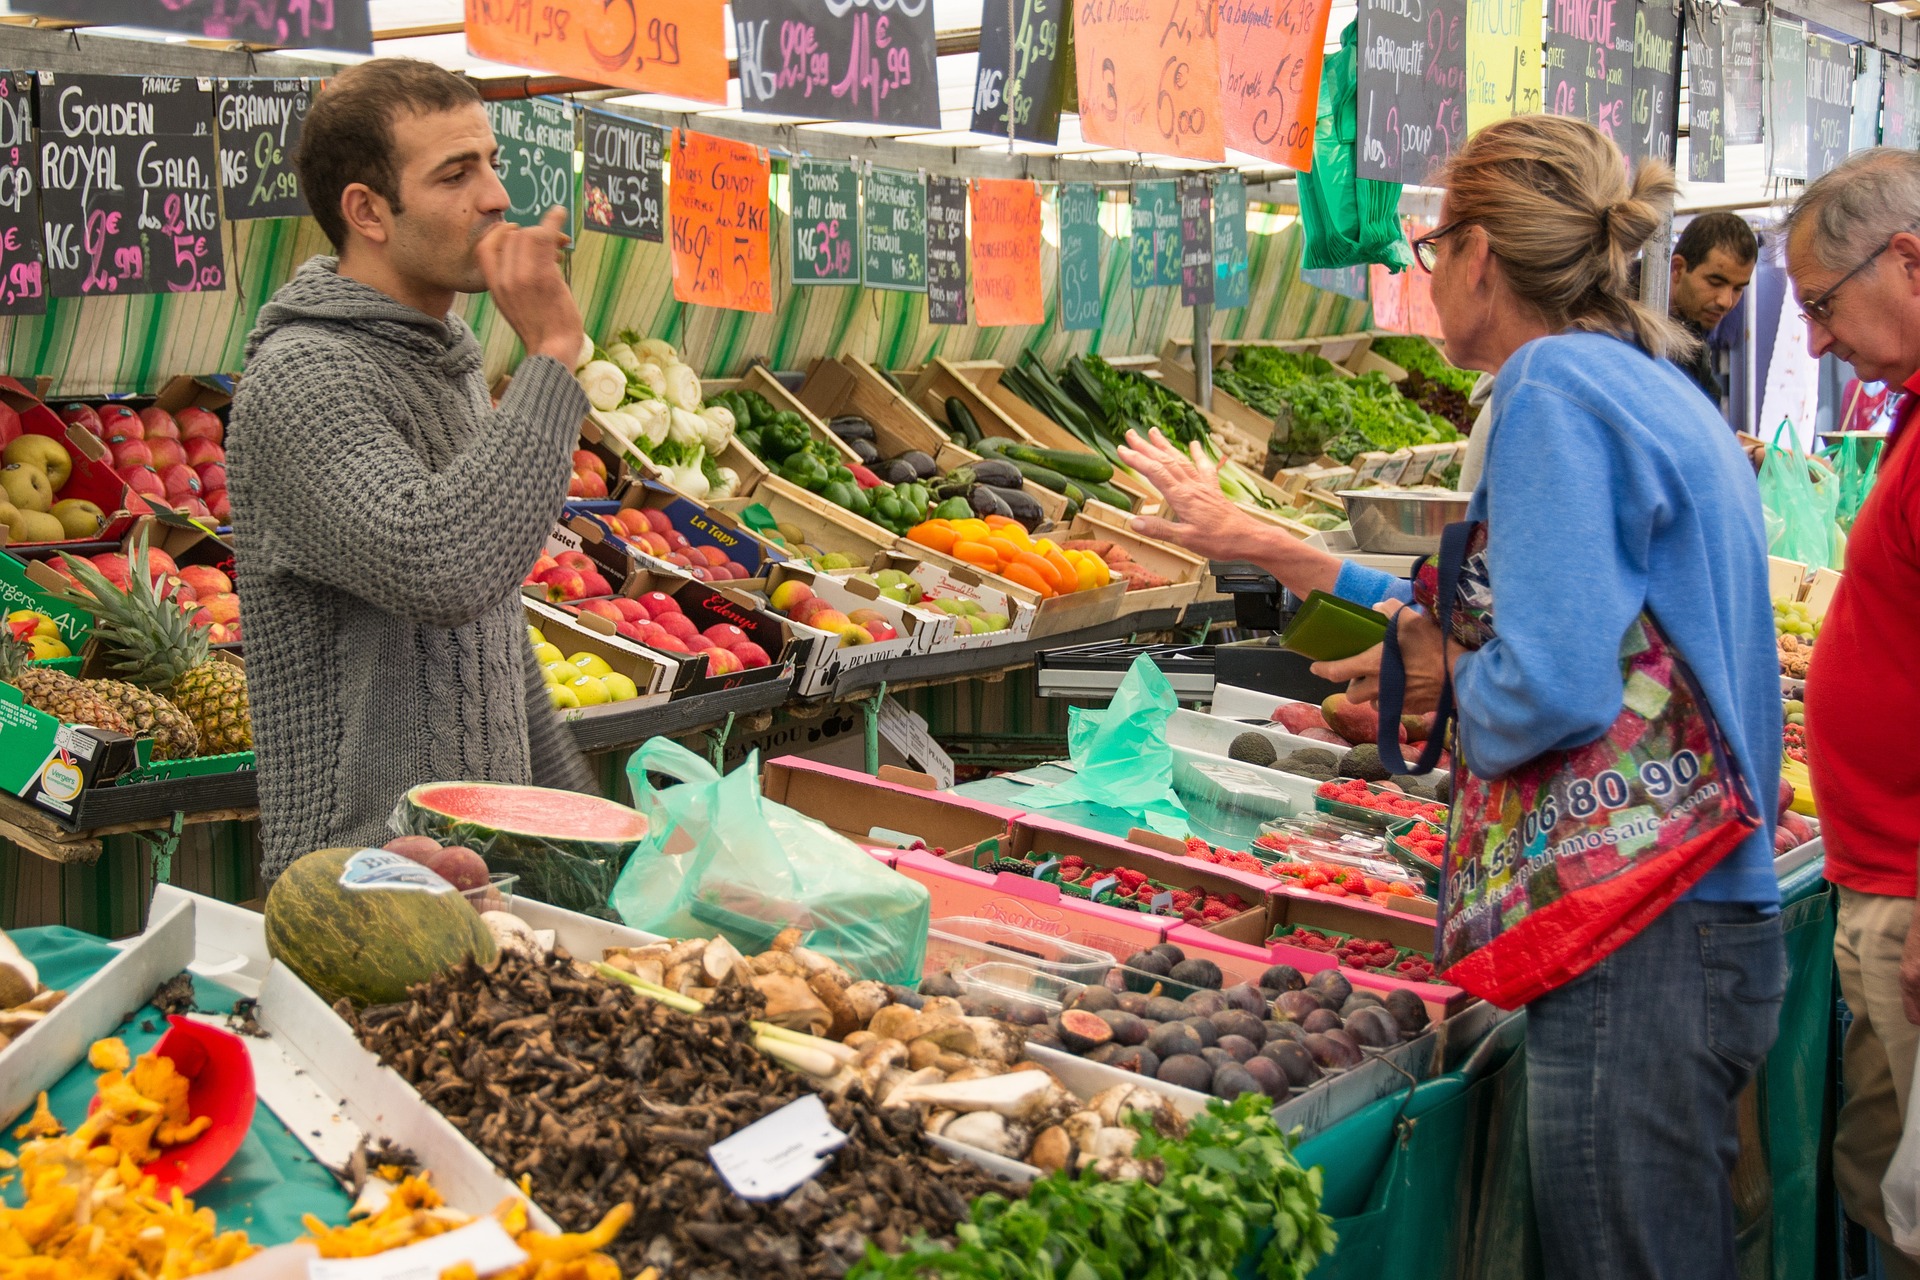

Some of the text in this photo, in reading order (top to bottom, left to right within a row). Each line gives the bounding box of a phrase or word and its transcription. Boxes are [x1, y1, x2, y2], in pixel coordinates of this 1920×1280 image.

[737, 18, 778, 102] KG
[142, 78, 182, 95] FRANCE
[975, 68, 1003, 115] KG
[1101, 57, 1118, 122] 3
[1631, 86, 1649, 125] KG
[59, 86, 154, 138] GOLDEN
[219, 93, 293, 147] GRANNY
[220, 148, 248, 188] KG
[594, 123, 649, 174] COMICE
[42, 141, 200, 208] ROYAL GALA
[608, 174, 625, 206] KG
[184, 191, 216, 231] KG
[892, 207, 910, 231] KG
[45, 221, 80, 270] KG
[797, 227, 818, 261] KG
[867, 225, 903, 255] FENOUIL
[552, 527, 577, 550] astet
[689, 514, 739, 547] La Tapy
[0, 579, 36, 611] ergers
[702, 593, 758, 631] Edenys
[725, 725, 804, 764] EANJOU
[51, 768, 76, 786] Vergers
[1449, 748, 1701, 908] 01 53 06 80 90
